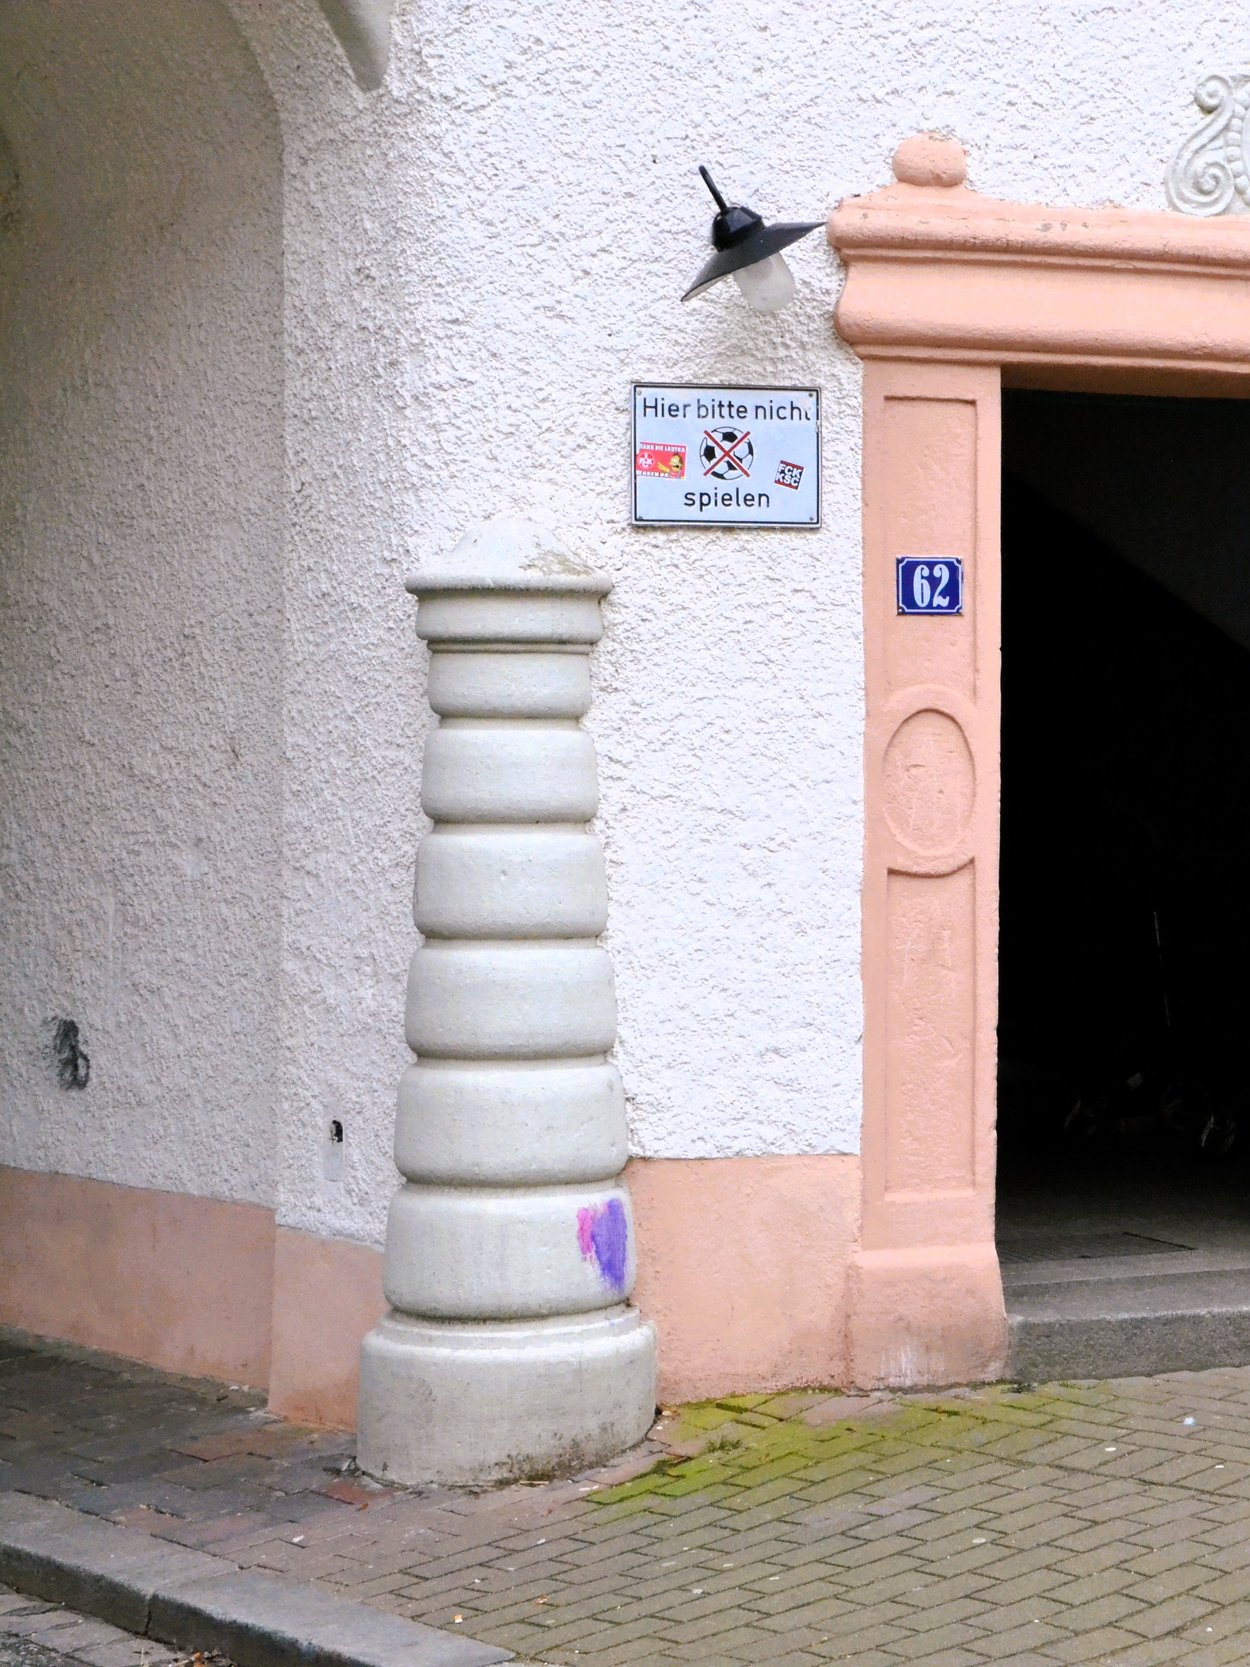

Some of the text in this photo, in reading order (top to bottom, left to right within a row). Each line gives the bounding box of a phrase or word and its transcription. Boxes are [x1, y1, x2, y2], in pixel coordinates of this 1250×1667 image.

[643, 397, 691, 418] Hier
[697, 398, 748, 419] bitte
[775, 473, 800, 487] KSC
[779, 464, 803, 478] FCK
[684, 487, 770, 512] spielen
[913, 564, 950, 607] 62
